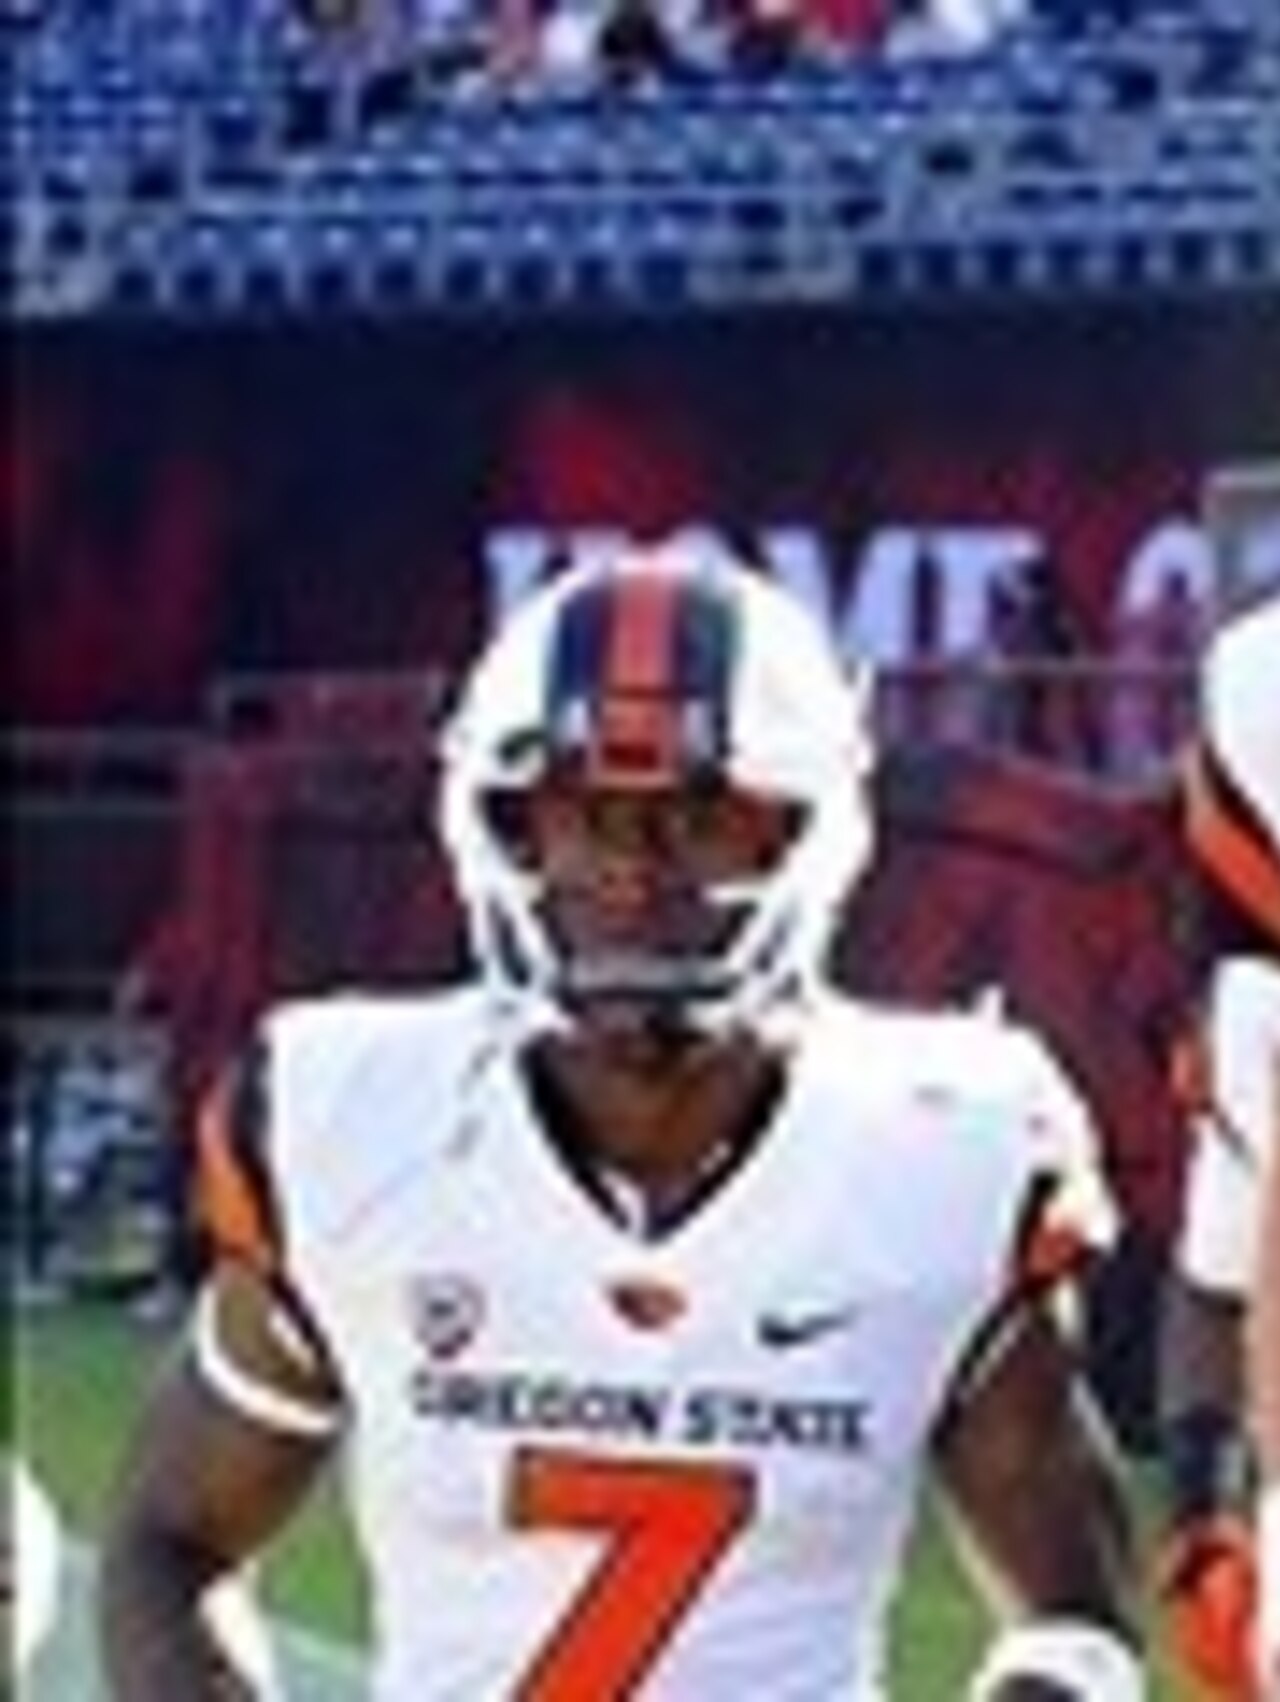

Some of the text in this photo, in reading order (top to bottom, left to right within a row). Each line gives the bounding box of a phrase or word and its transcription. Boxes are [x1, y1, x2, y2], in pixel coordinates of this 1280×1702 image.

[411, 1369, 871, 1449] OREGON STATE
[506, 1449, 758, 1702] 7
